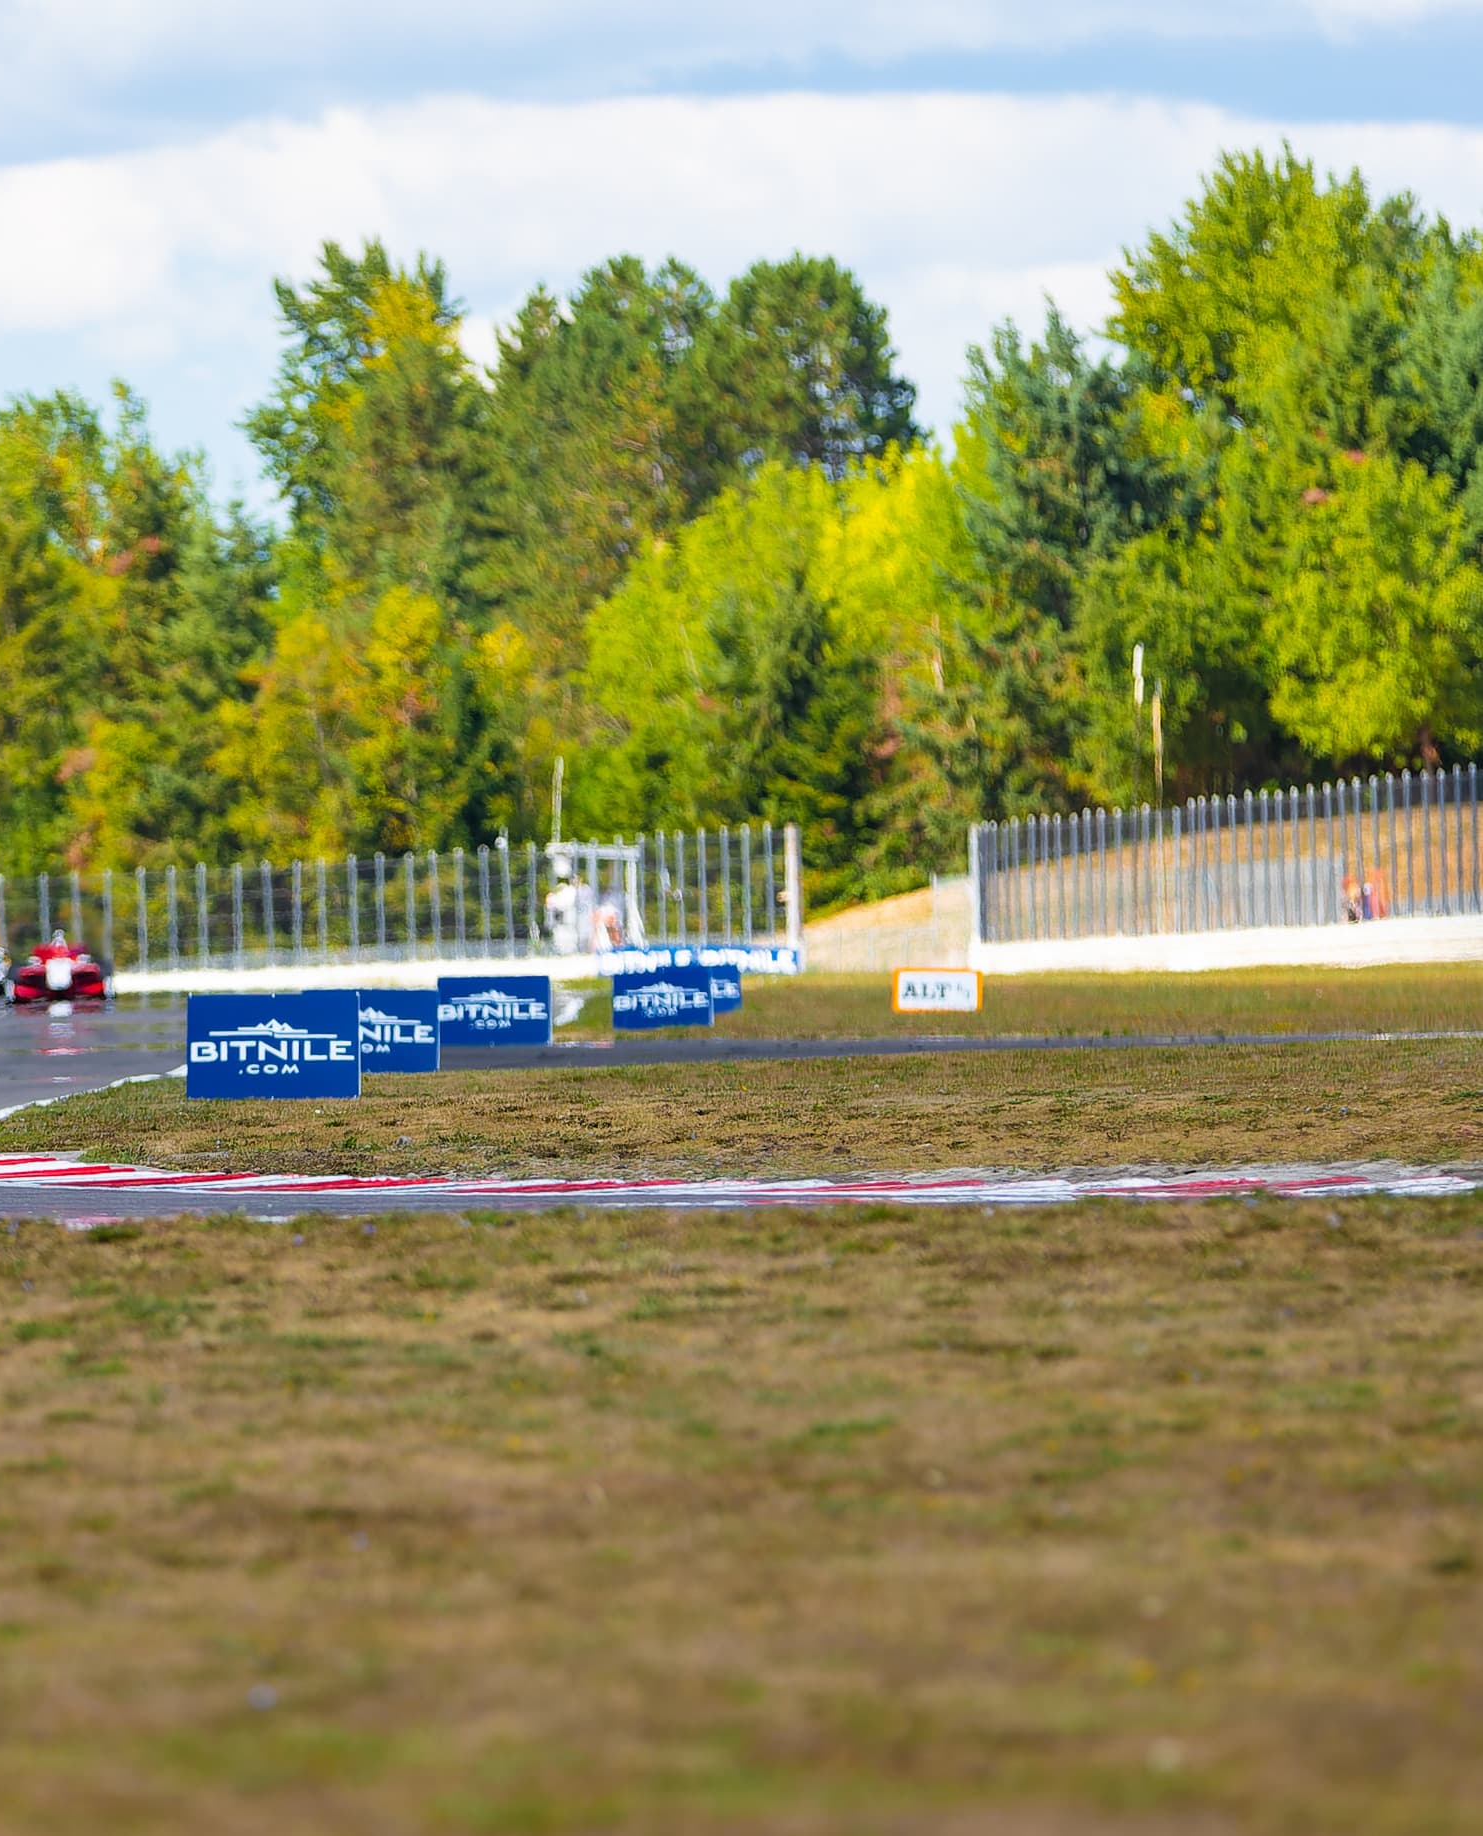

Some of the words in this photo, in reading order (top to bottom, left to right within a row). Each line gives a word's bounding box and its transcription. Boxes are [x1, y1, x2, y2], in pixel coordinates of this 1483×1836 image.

[613, 991, 709, 1011] BITNILE
[437, 1002, 548, 1021] BITNILE
[359, 1024, 436, 1044] NILE
[190, 1040, 355, 1063] BITNILE
[238, 1064, 300, 1075] .COM
